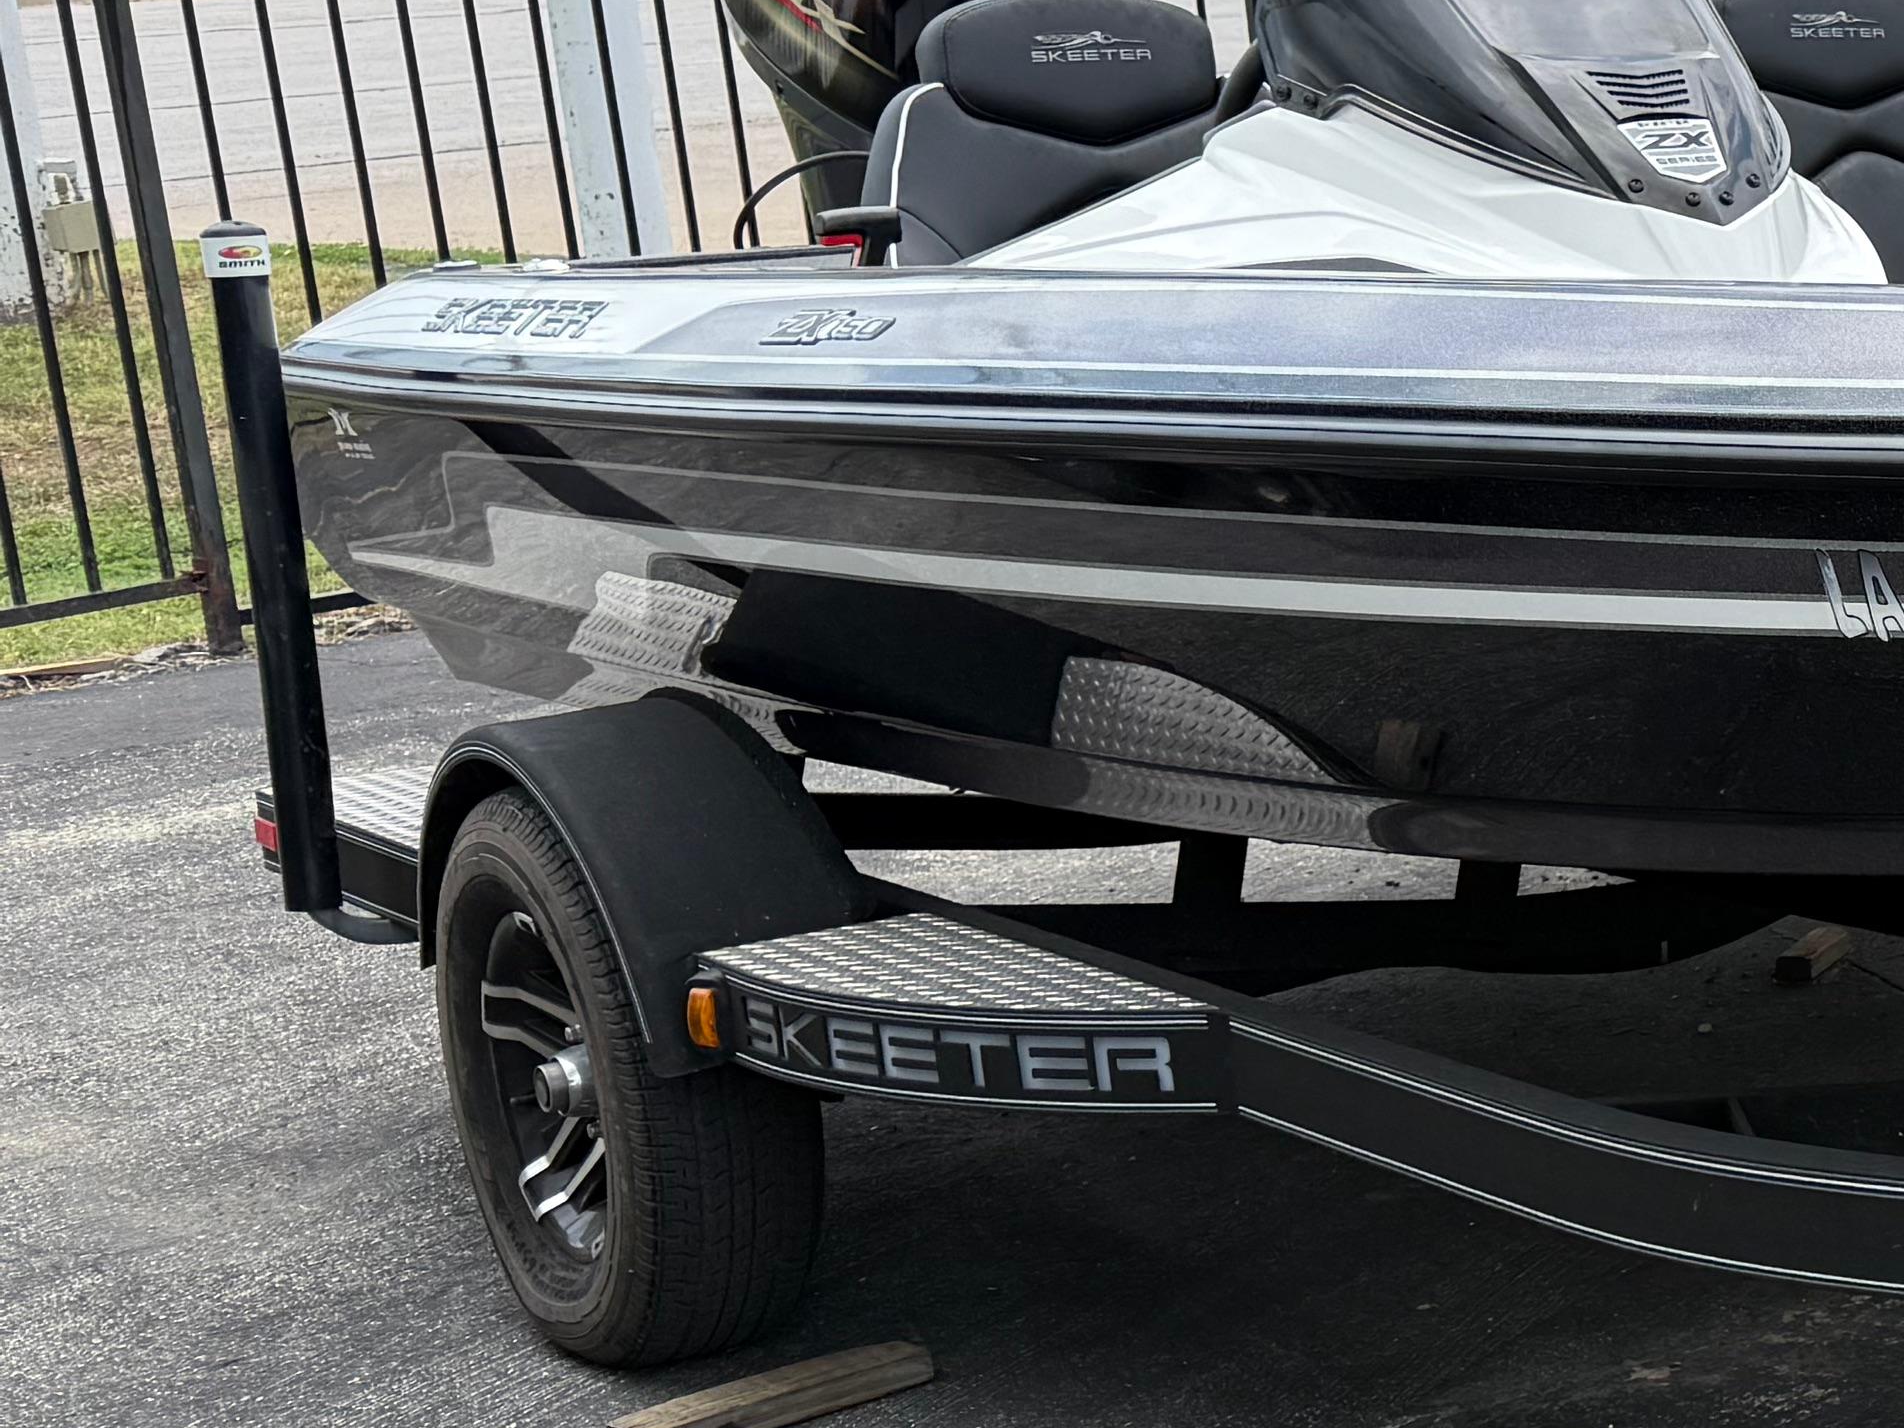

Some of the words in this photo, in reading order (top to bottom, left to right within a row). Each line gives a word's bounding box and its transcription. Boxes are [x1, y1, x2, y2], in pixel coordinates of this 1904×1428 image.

[1790, 27, 1886, 39] SKEETER
[1031, 48, 1152, 63] SKEETER
[1639, 130, 1710, 151] ZX
[421, 298, 609, 339] SKEETER
[746, 998, 1176, 1092] SKEETER
